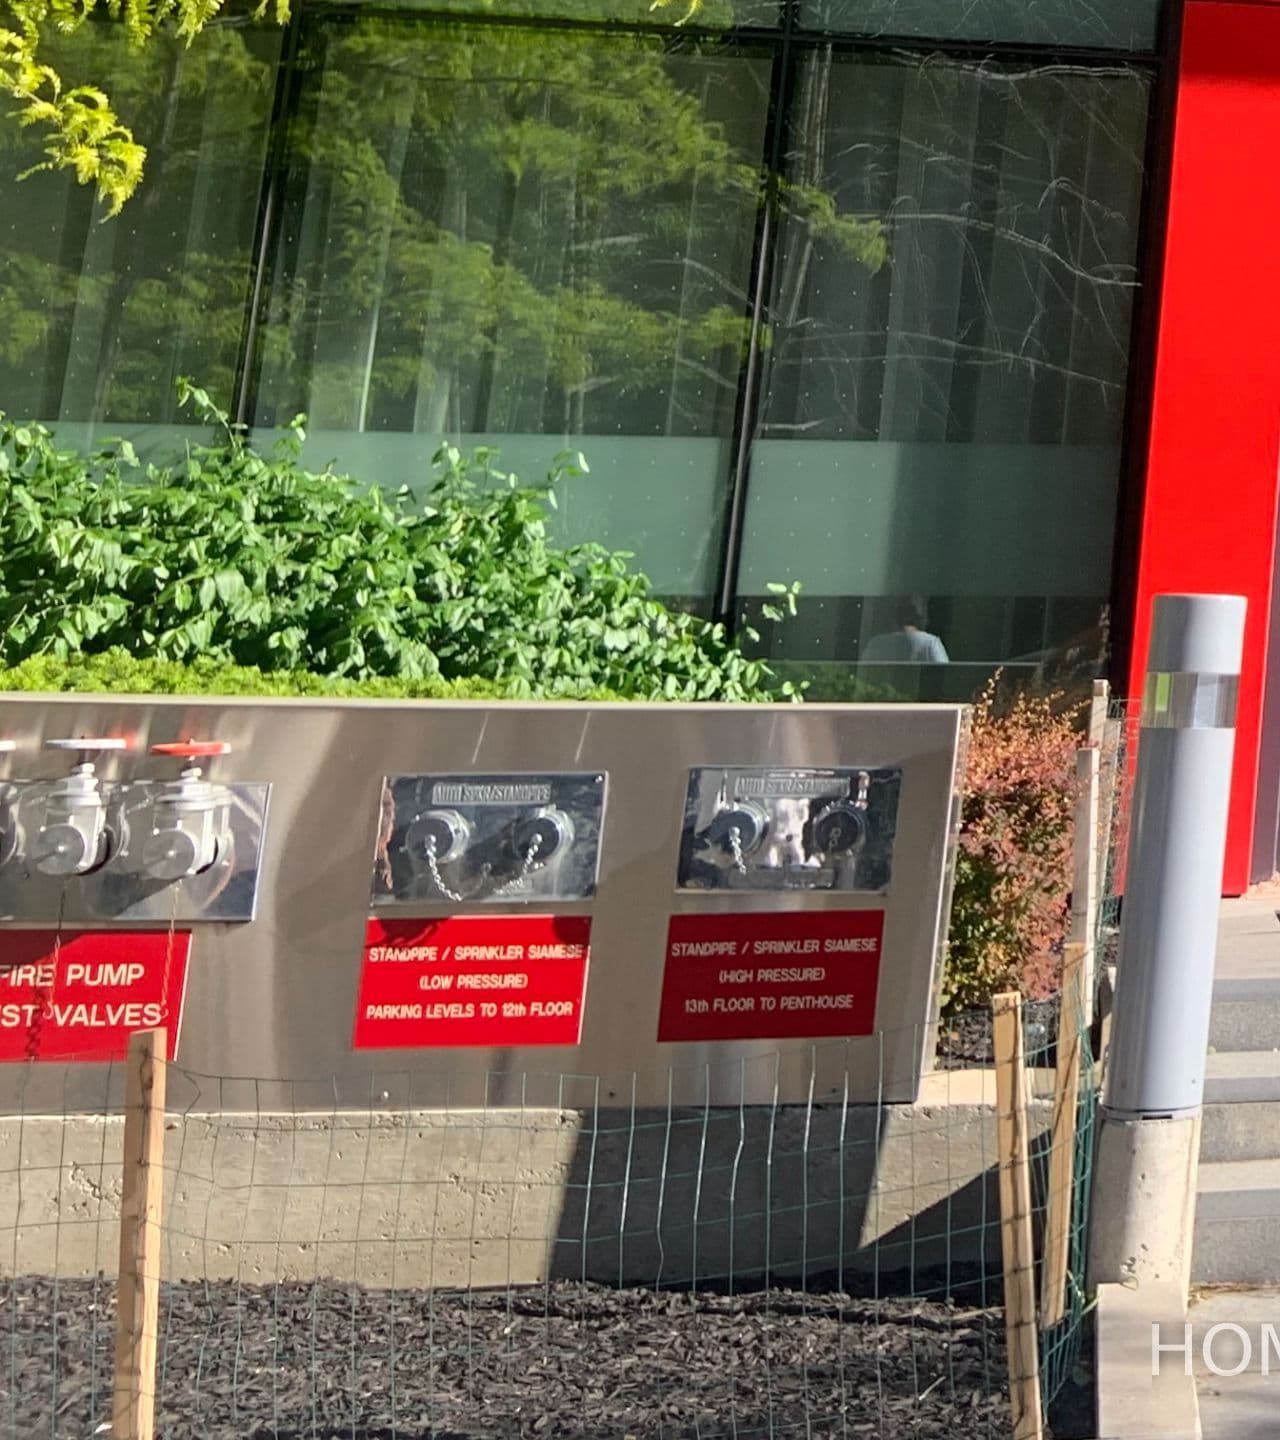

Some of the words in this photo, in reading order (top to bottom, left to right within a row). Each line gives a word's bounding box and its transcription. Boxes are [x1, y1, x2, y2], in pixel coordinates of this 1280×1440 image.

[369, 946, 438, 962] STANDPIPE
[441, 946, 450, 961] /
[454, 945, 524, 960] SPRINKLER
[528, 944, 584, 959] SIAMESE
[671, 941, 737, 957] STANDPIPE
[741, 940, 750, 955] /
[753, 939, 820, 954] SPRINKLER
[824, 937, 878, 953] SIAMESE
[66, 963, 145, 987] PUMP
[419, 975, 454, 990] (LOW
[456, 973, 528, 989] PRESSURE)
[756, 967, 826, 982] PRESSURE)
[366, 1004, 422, 1019] PARKING
[425, 1003, 475, 1019] LEVELS
[479, 1003, 497, 1017] TO
[501, 1002, 527, 1017] 12th
[529, 1001, 573, 1016] FLOOR
[713, 997, 755, 1012] FLOOR
[760, 996, 776, 1010] TO
[780, 994, 854, 1010] PENTHOUSE
[0, 1004, 40, 1028] ST
[53, 1003, 162, 1027] VALVES
